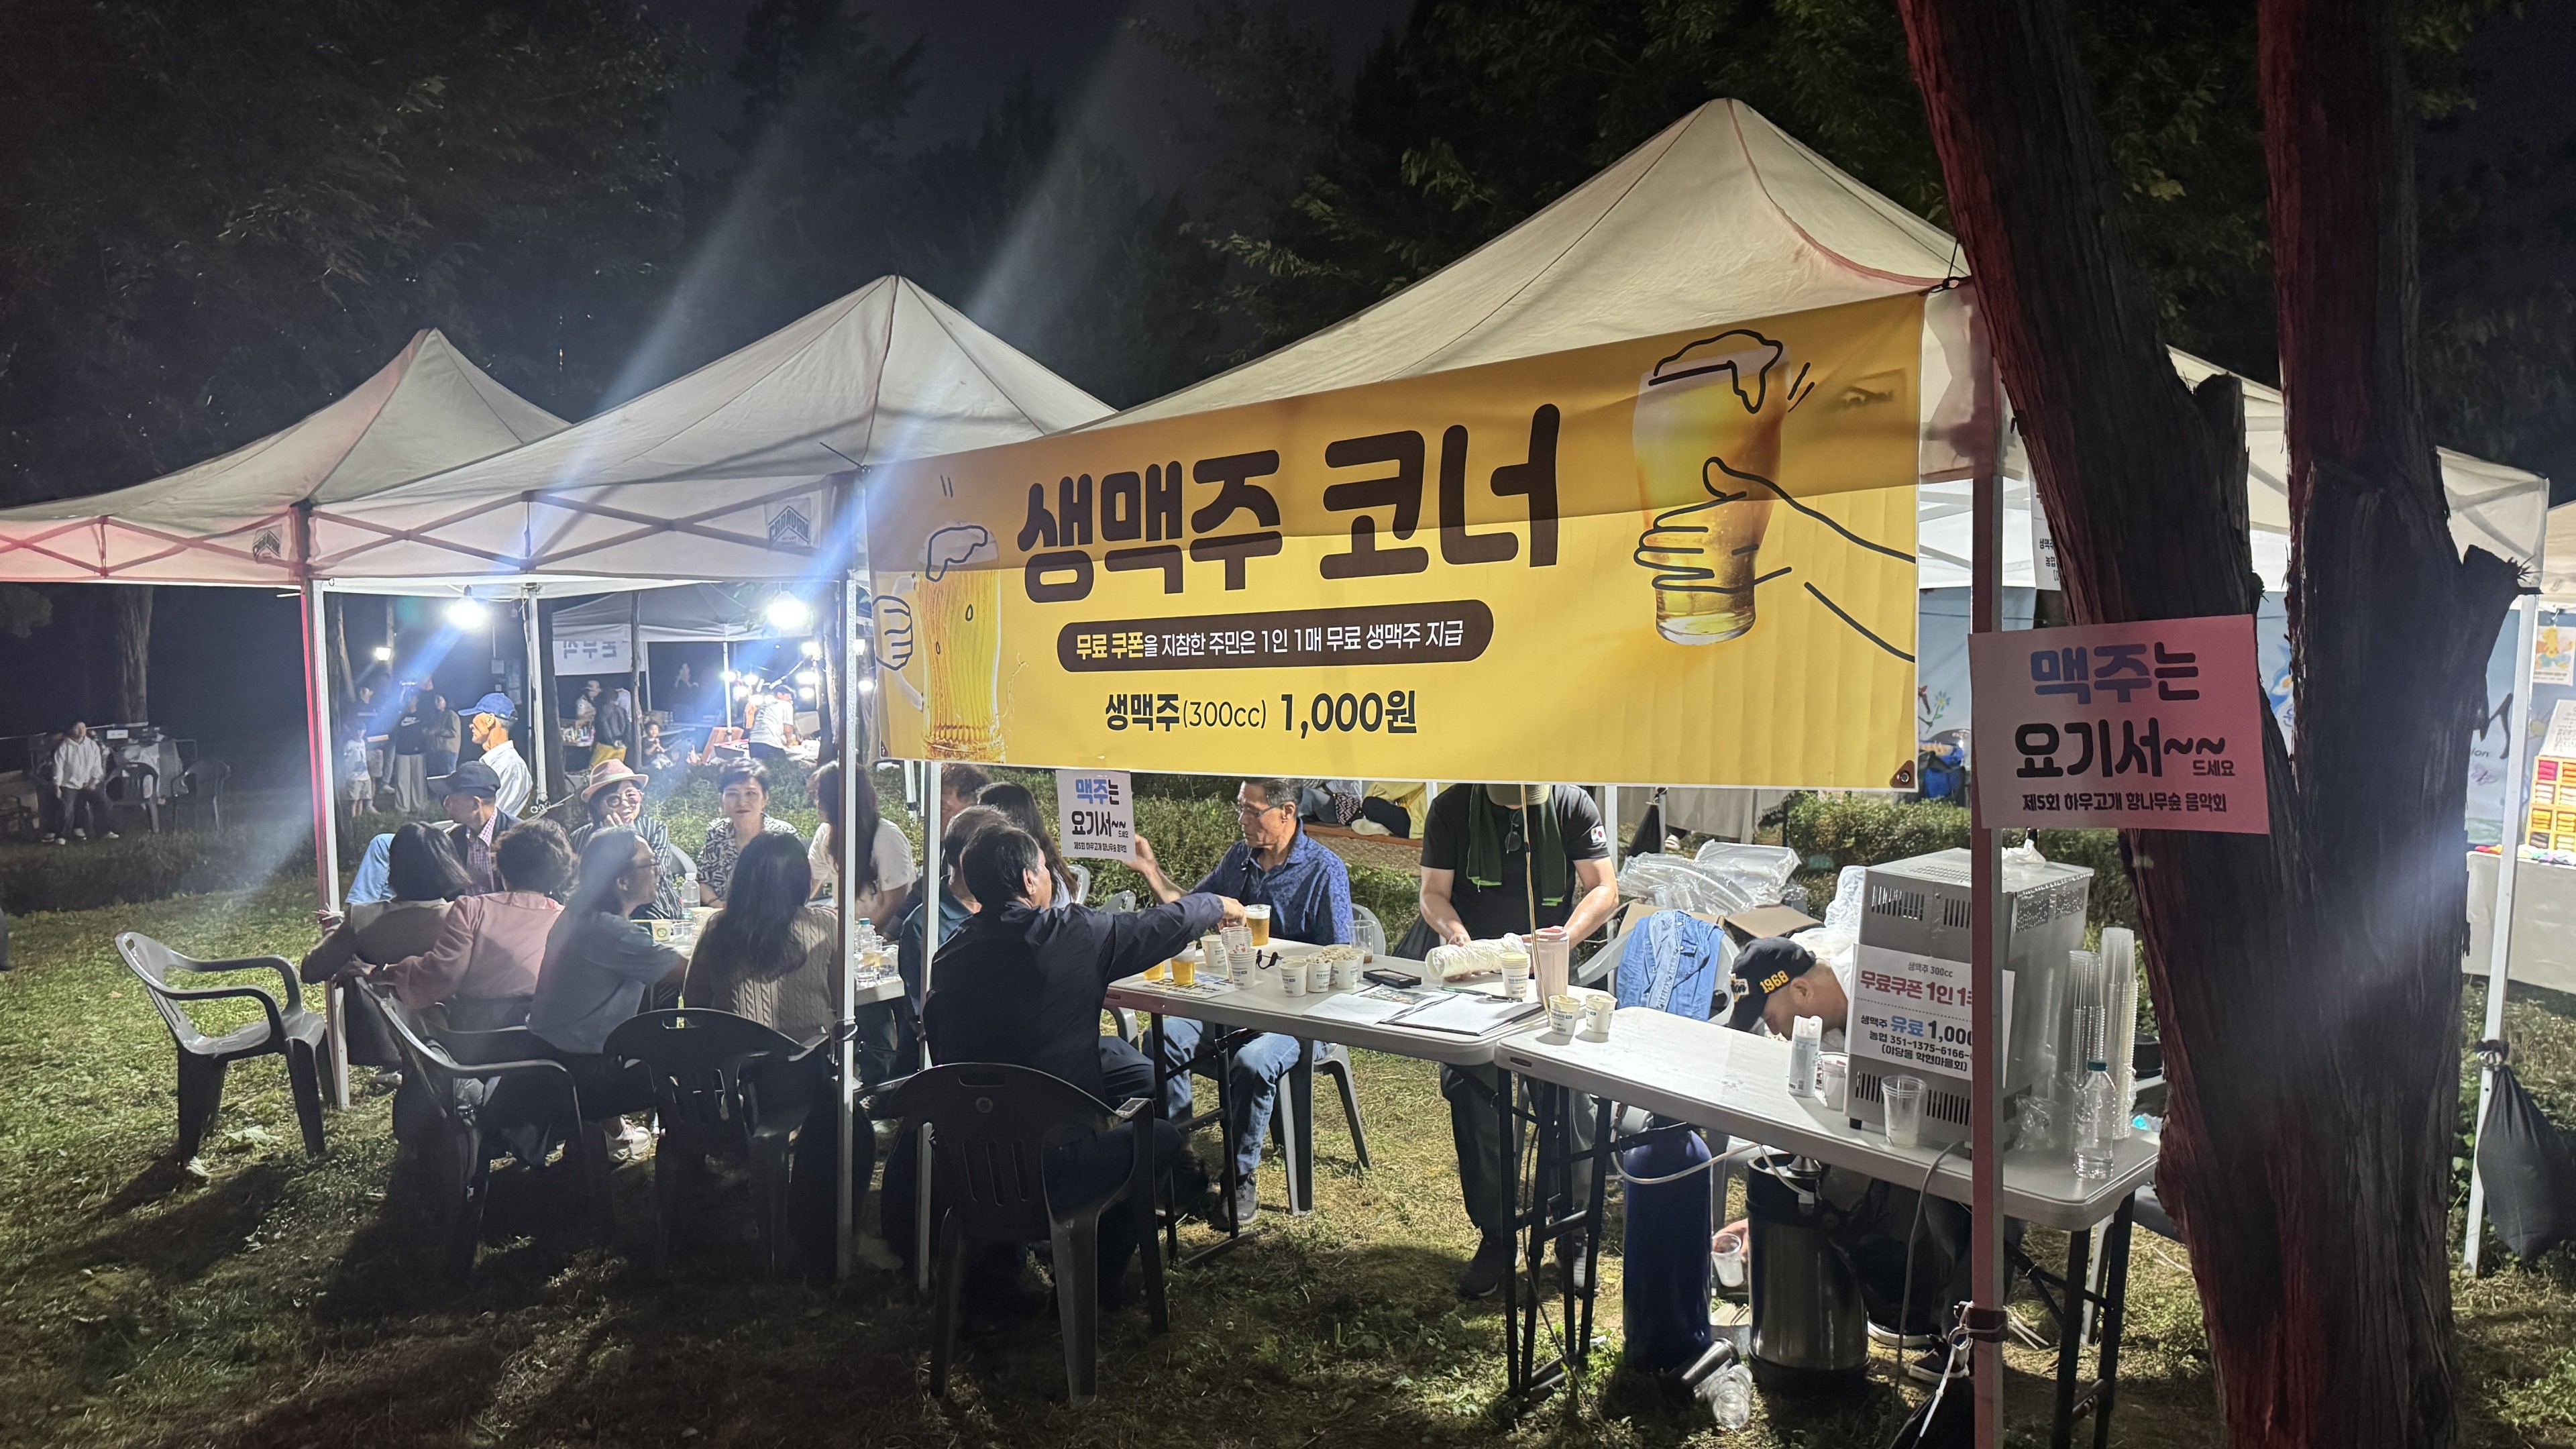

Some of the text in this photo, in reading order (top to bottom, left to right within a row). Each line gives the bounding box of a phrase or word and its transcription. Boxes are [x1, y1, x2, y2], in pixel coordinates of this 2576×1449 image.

[1016, 404, 1561, 603] 생맥주 코너
[1077, 621, 1464, 659] 무료 쿠폰을 지참한 주민은 1인 1매 무료 생맥주 지급
[2031, 641, 2200, 704] 맥주는
[1106, 690, 1417, 739] 생맥주(300cc) 1,000원
[2193, 760, 2235, 776] 드세요
[1075, 779, 1119, 805] 맥주는
[2023, 792, 2226, 812] 제5회 하우고개 향나무숲 음악회
[1760, 971, 1789, 994] 1968
[1908, 961, 1953, 977] 생맥주 300cc
[1860, 970, 1923, 1000] 무료쿠폰
[1926, 981, 1953, 1005] 1인
[1861, 1014, 1888, 1028] 생맥주
[1890, 1015, 1924, 1038] 유료
[1869, 1030, 1972, 1060] 농협 351-1375-6166-
